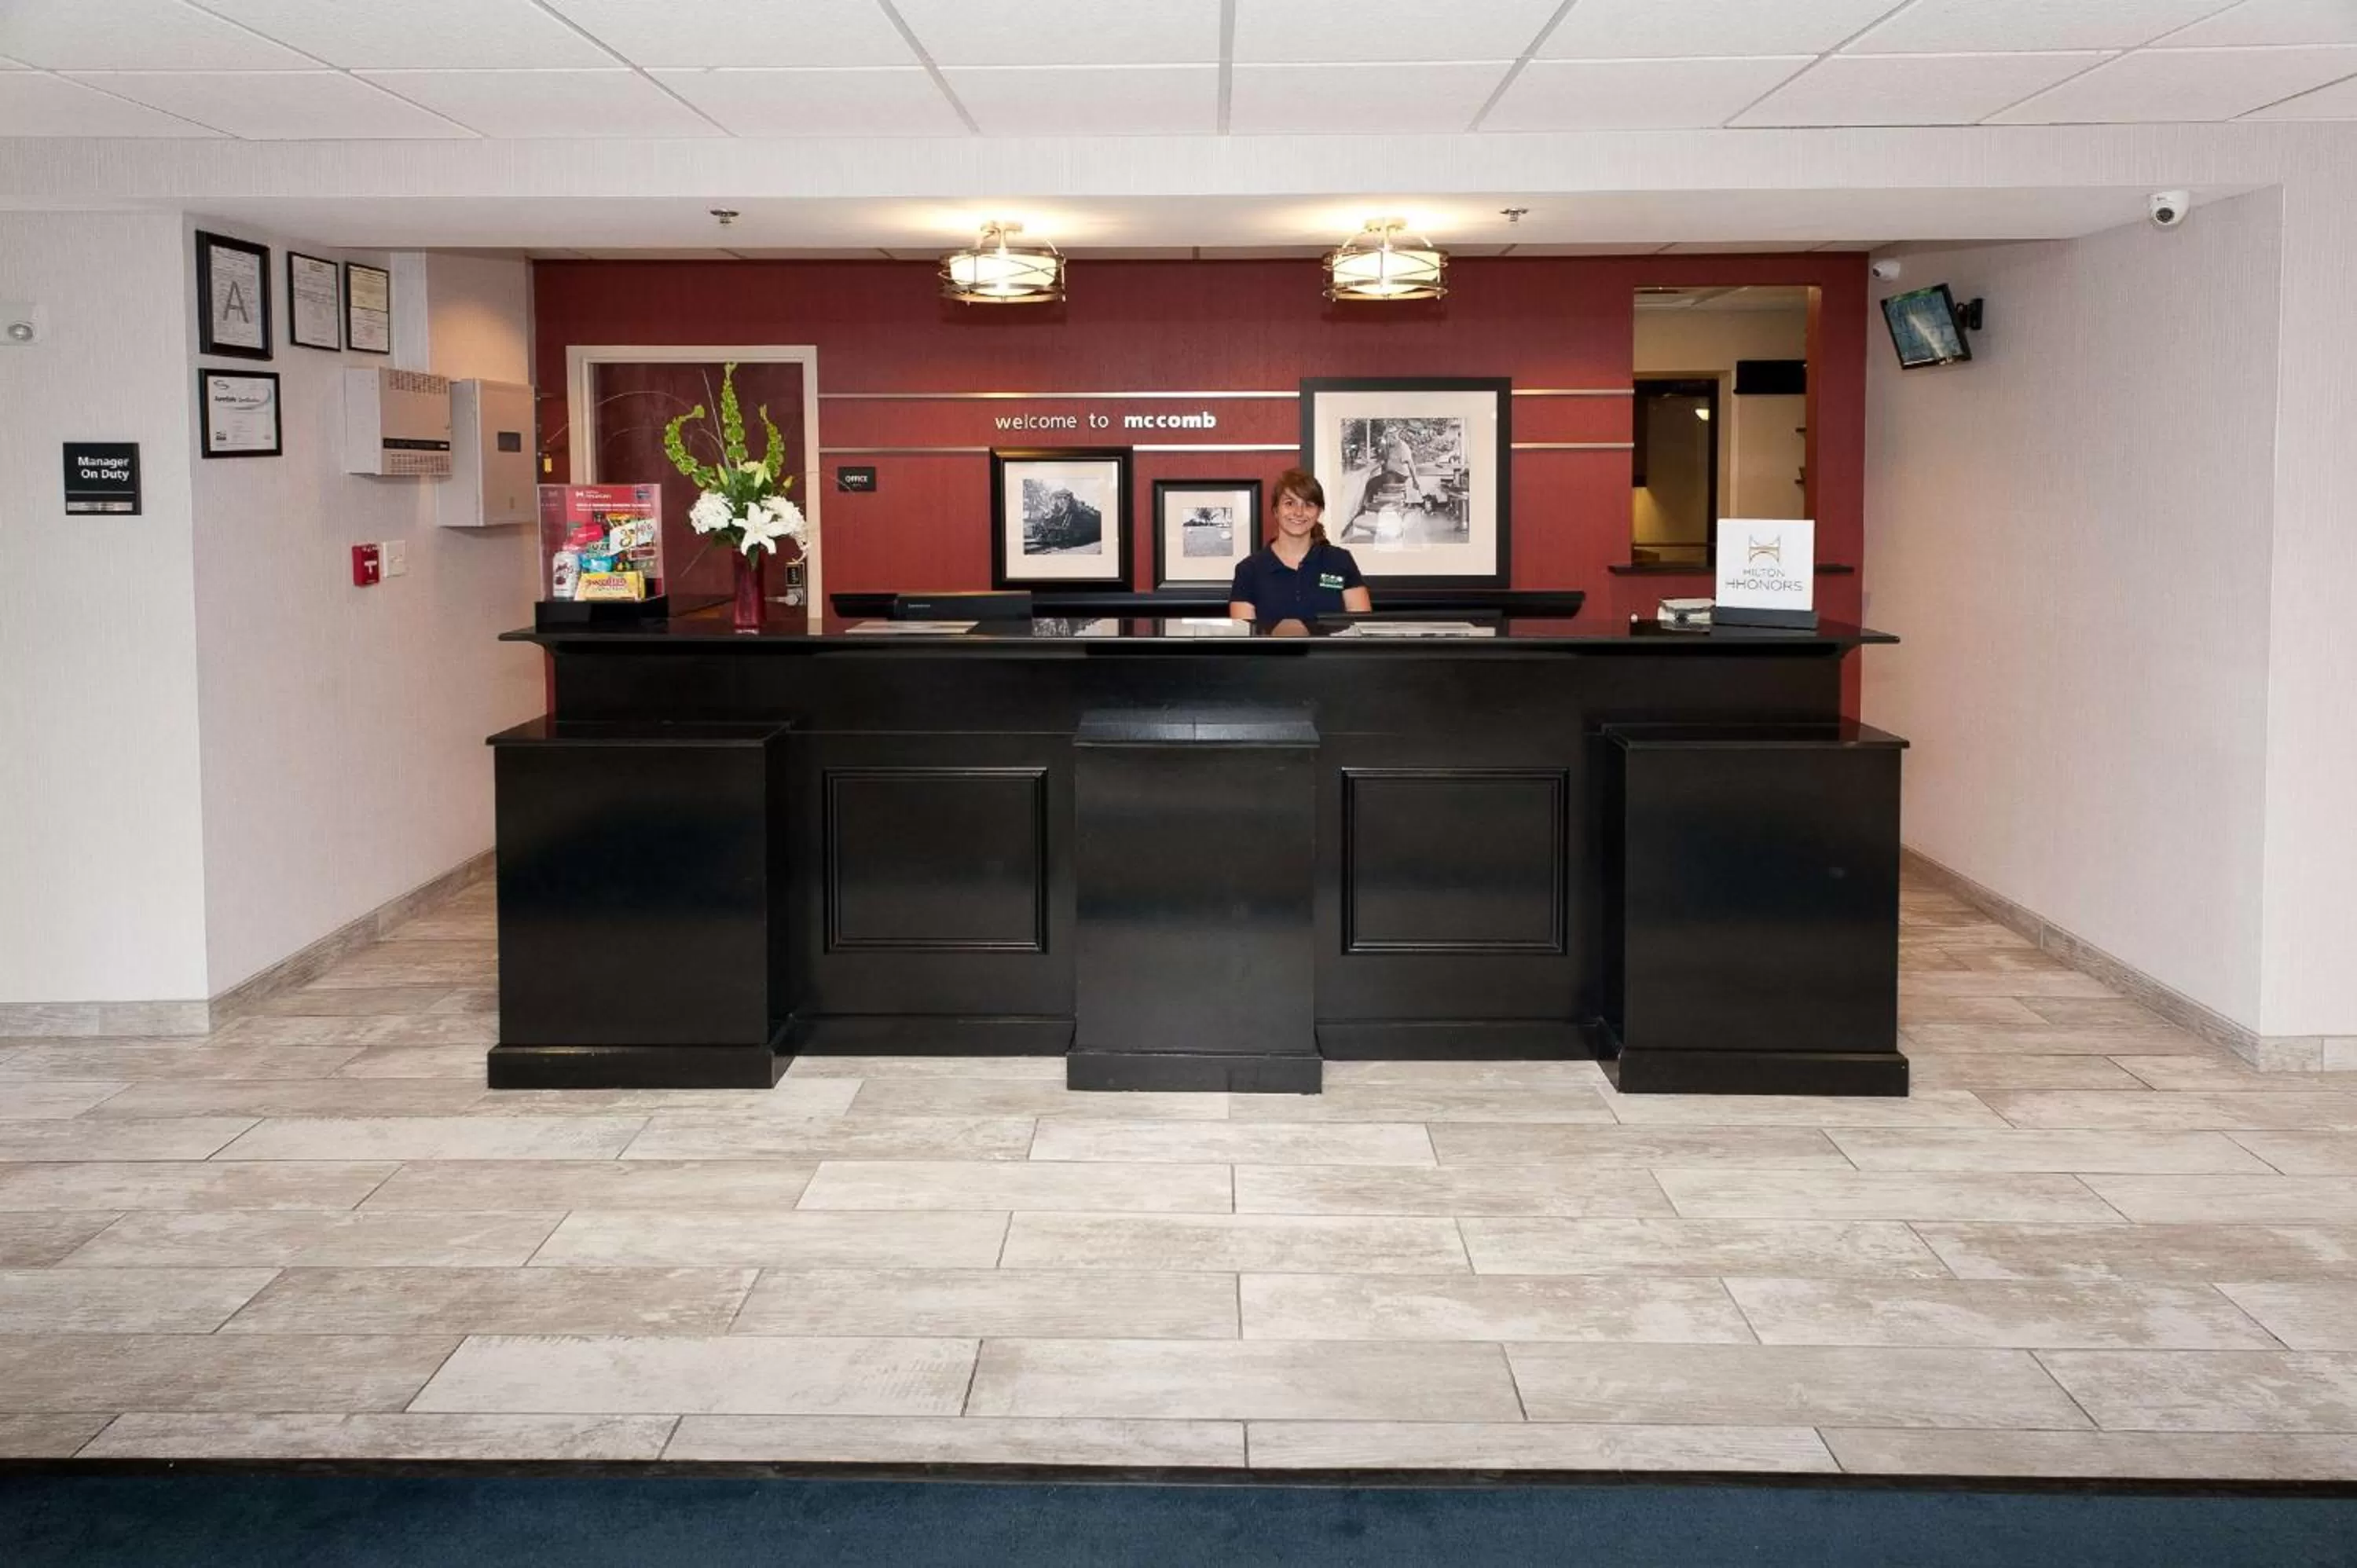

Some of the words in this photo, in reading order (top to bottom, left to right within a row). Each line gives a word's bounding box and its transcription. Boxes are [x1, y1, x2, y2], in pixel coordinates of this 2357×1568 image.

[222, 280, 249, 324] A
[995, 412, 1077, 430] welcome
[1088, 412, 1109, 428] to
[1124, 411, 1217, 428] mccomb
[78, 456, 130, 469] Manager
[81, 469, 98, 478] On
[101, 469, 130, 482] Duty
[1742, 568, 1786, 577] HILTON
[1725, 578, 1804, 592] HHONORS
